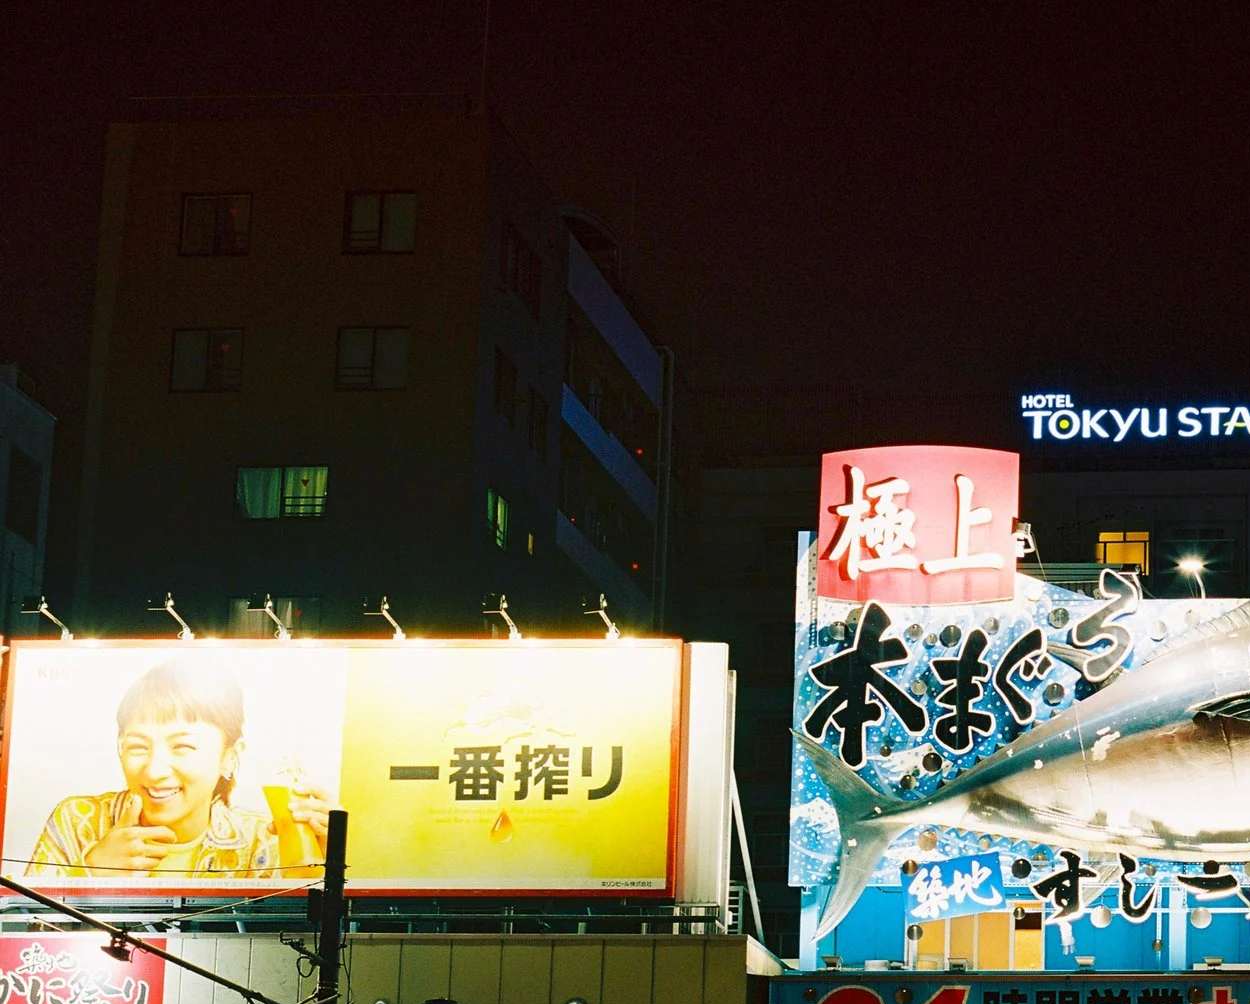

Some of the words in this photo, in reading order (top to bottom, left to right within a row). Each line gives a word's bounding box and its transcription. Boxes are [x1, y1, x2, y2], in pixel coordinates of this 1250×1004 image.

[1022, 394, 1074, 408] HOTEL
[1022, 407, 1168, 442] TOKYU
[828, 464, 1005, 581] 極上
[801, 568, 1140, 771] 本まぐろ
[389, 744, 624, 801] 一番搾り
[906, 858, 1001, 920] 築地
